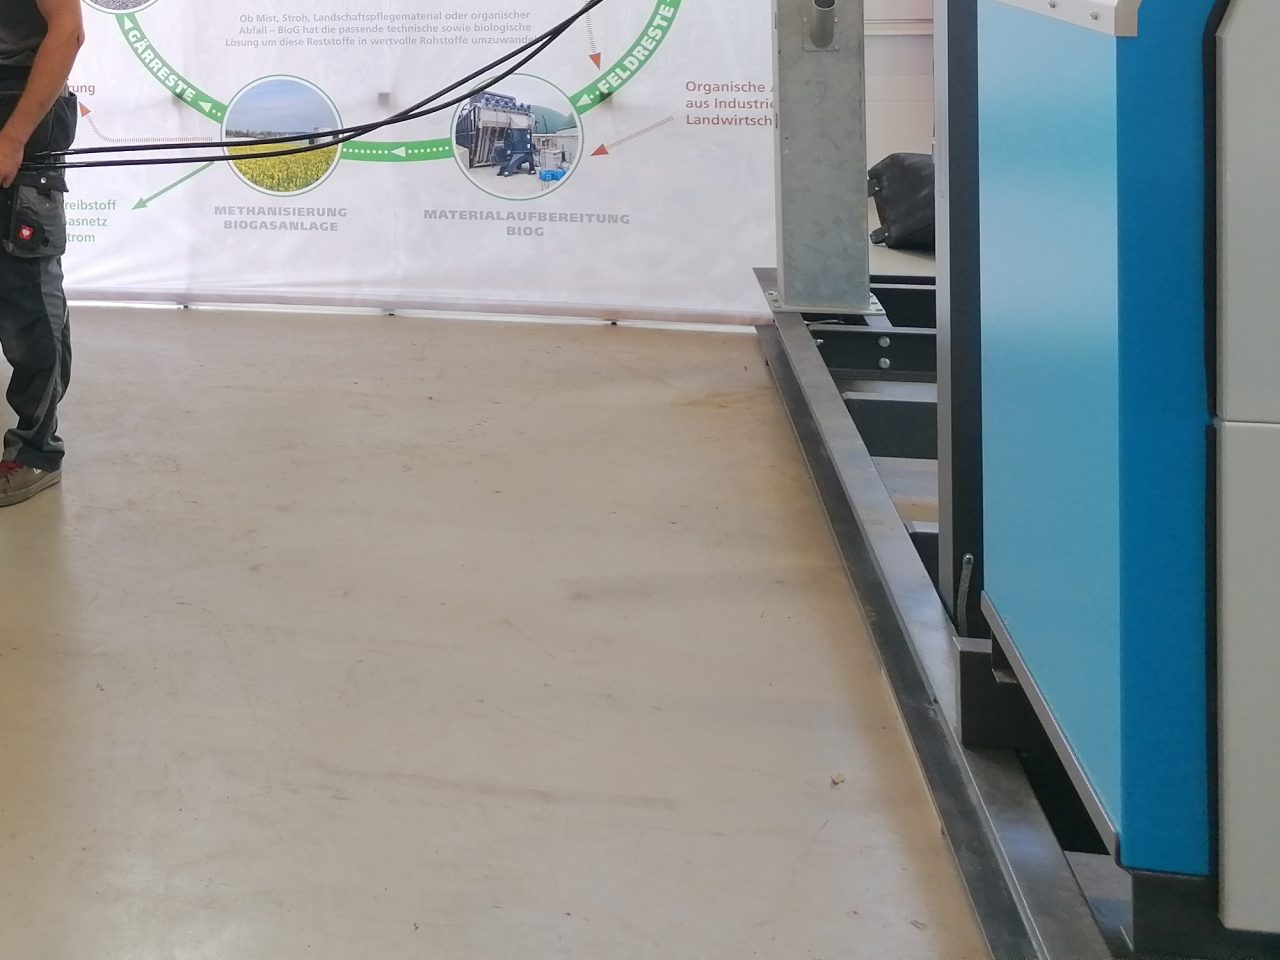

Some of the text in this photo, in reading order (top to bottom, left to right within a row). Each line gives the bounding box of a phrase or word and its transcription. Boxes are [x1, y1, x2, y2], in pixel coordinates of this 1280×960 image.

[239, 10, 531, 24] Ob Mist, Stroh, Landschaftspflegematerial oder organischer
[239, 26, 267, 35] Abfall
[278, 26, 300, 34] BioG
[302, 26, 319, 34] hat
[321, 25, 336, 33] die
[339, 24, 384, 36] passende
[387, 24, 439, 33] technische
[441, 23, 471, 32] sowie
[474, 23, 532, 34] biologische
[225, 35, 537, 48] Lösung um diese Reststoffe in wertvolle Rohstoffe umzuwande
[596, 4, 675, 95] FELDRESTE
[128, 29, 197, 102] GÄRRESTE
[68, 84, 96, 96] rung
[685, 80, 766, 95] Organische
[686, 100, 710, 109] aus
[686, 114, 773, 126] Landwirtsch
[64, 199, 118, 210] reibstoff
[214, 205, 347, 217] METHANISIERUNG
[423, 209, 630, 225] MATERIALAUFBEREITUNG
[64, 216, 108, 227] asnetz
[223, 220, 338, 232] BIOGASANLAGE
[67, 232, 96, 242] trom
[506, 225, 545, 237] BIOG
